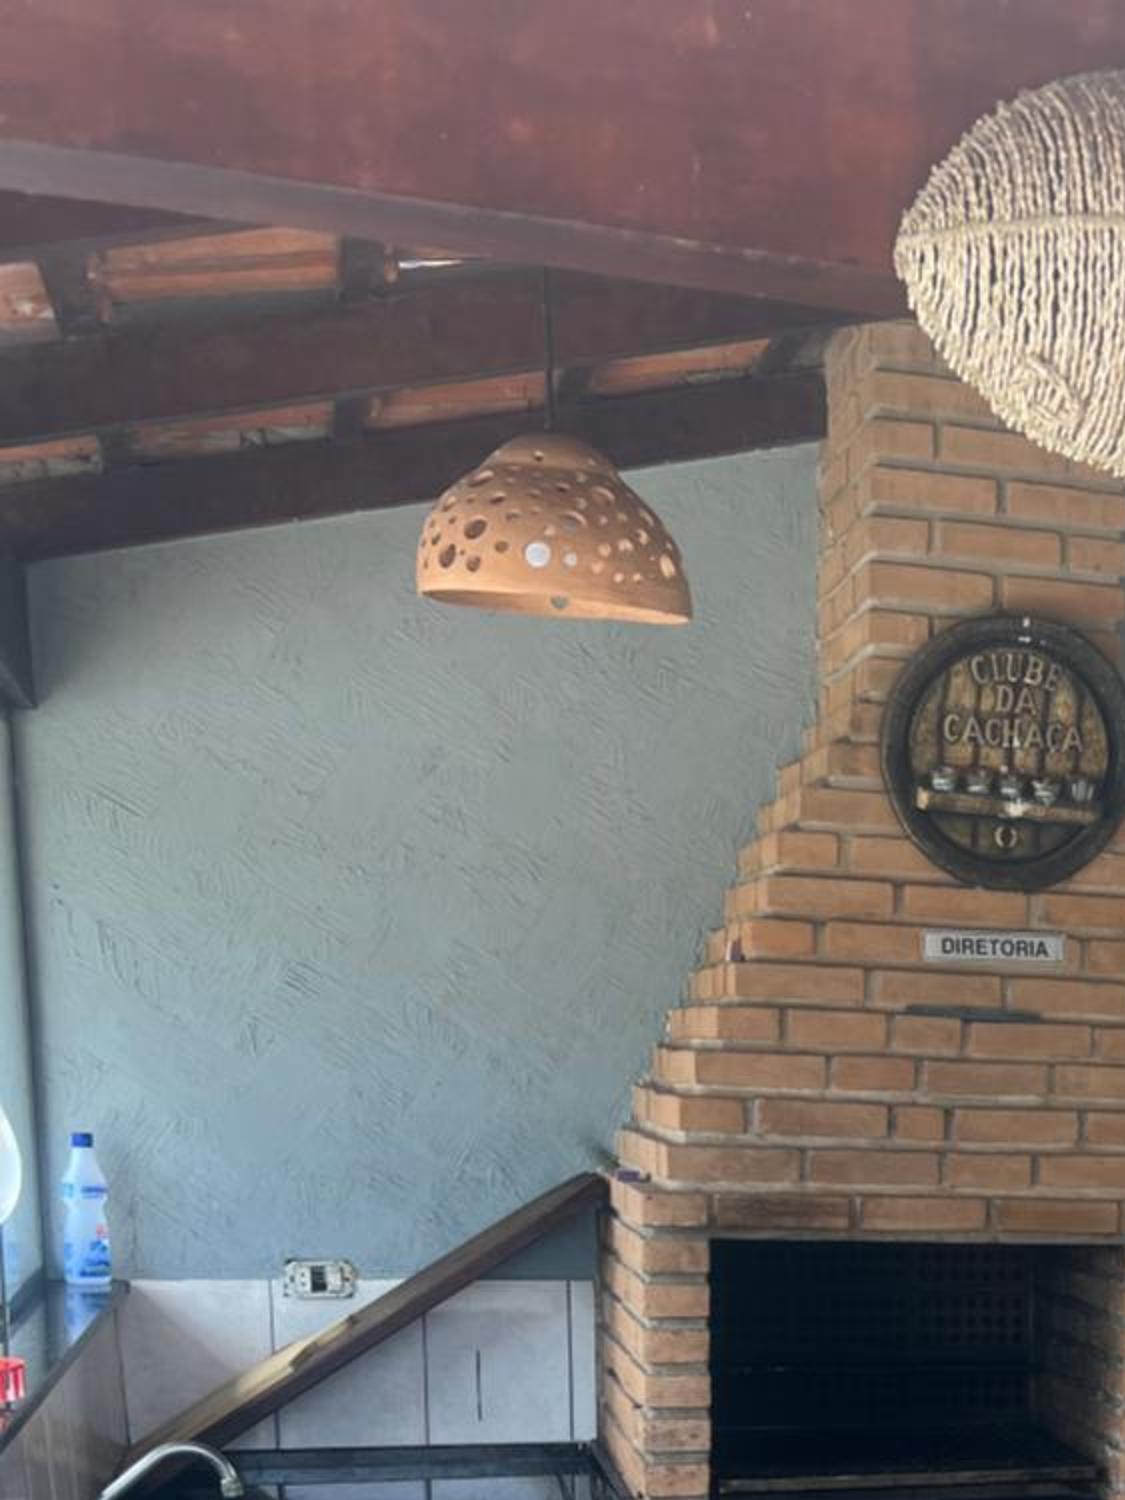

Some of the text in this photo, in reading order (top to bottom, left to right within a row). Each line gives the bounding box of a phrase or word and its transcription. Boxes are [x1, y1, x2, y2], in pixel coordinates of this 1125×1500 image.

[970, 652, 1062, 691] CLUBE
[995, 684, 1038, 715] DA
[943, 713, 1083, 753] CACHAÇA
[941, 937, 1050, 958] DIRETORIA
